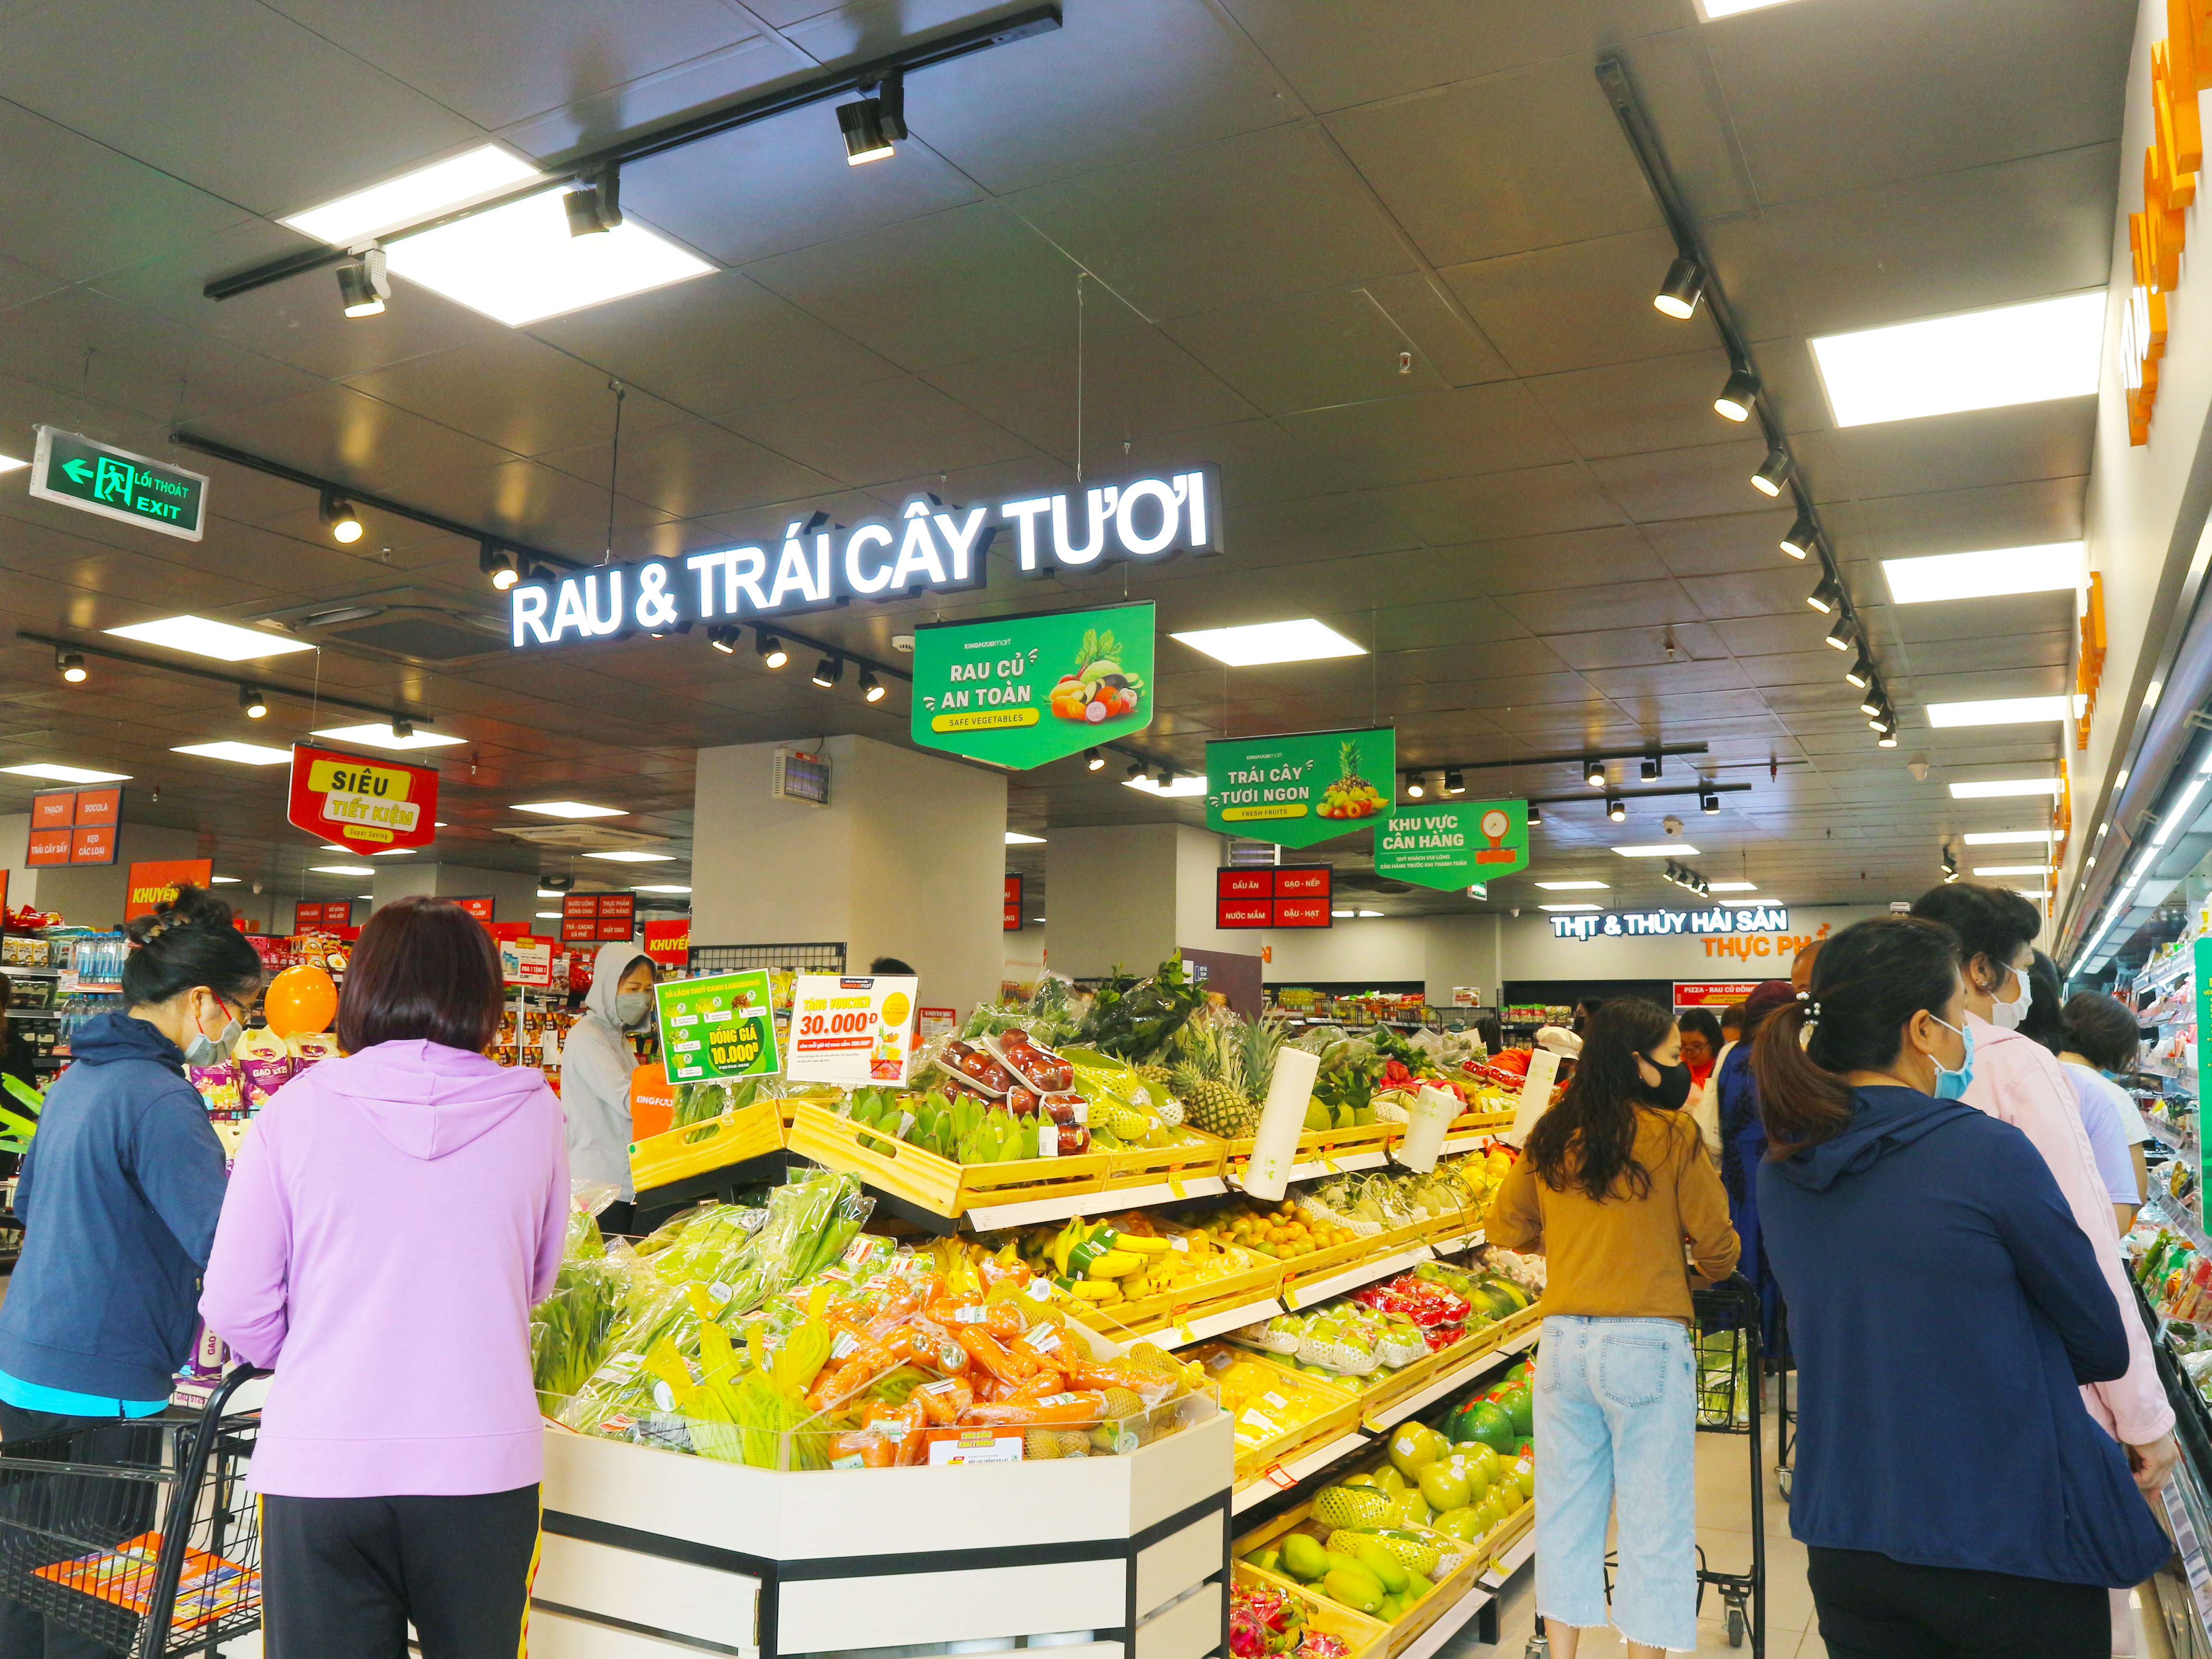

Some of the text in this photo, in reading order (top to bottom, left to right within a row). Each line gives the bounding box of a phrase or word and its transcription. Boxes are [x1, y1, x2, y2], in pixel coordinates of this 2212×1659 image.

[134, 471, 189, 498] LỐI THOÁT
[137, 496, 181, 519] EXIT
[512, 471, 1207, 647] RAU & TRÁI CÂY TƯƠI
[950, 652, 1024, 682] RAU CỦ
[941, 680, 1031, 709] AN TOÀN
[950, 714, 1023, 726] SAFE VEGETABLES
[332, 768, 388, 796] SIÊU
[1228, 763, 1302, 784] TRÁI CÂY
[1220, 786, 1309, 804] TƯƠI NGON
[44, 805, 63, 815] THẠCH
[85, 804, 108, 812] SOCOLA
[332, 797, 414, 827] TIẾT KIỆM
[1389, 814, 1457, 833] KHU VỰC
[87, 835, 98, 844] KẸO
[350, 829, 388, 841] Super Saving
[1382, 830, 1464, 850] CÂN HÀNG
[32, 842, 68, 854] TRÁI CÂY SẤY
[79, 846, 105, 856] CÁC LOẠI
[1306, 878, 1320, 887] NẾP
[1226, 911, 1246, 919] NƯỚC
[1284, 908, 1299, 918] ĐẬU
[1305, 910, 1319, 918] HẠT
[1551, 906, 1787, 940] THỊT & THỦY HẢI SẢN
[1702, 934, 1770, 961] THỰC
[674, 988, 689, 997] LÁCH
[725, 979, 760, 990] LANGBIANG
[830, 996, 871, 1010] VOUCHER
[739, 1023, 757, 1041] GIÁ
[253, 1068, 271, 1077] GẠO
[636, 1095, 673, 1107] KINGFOO
